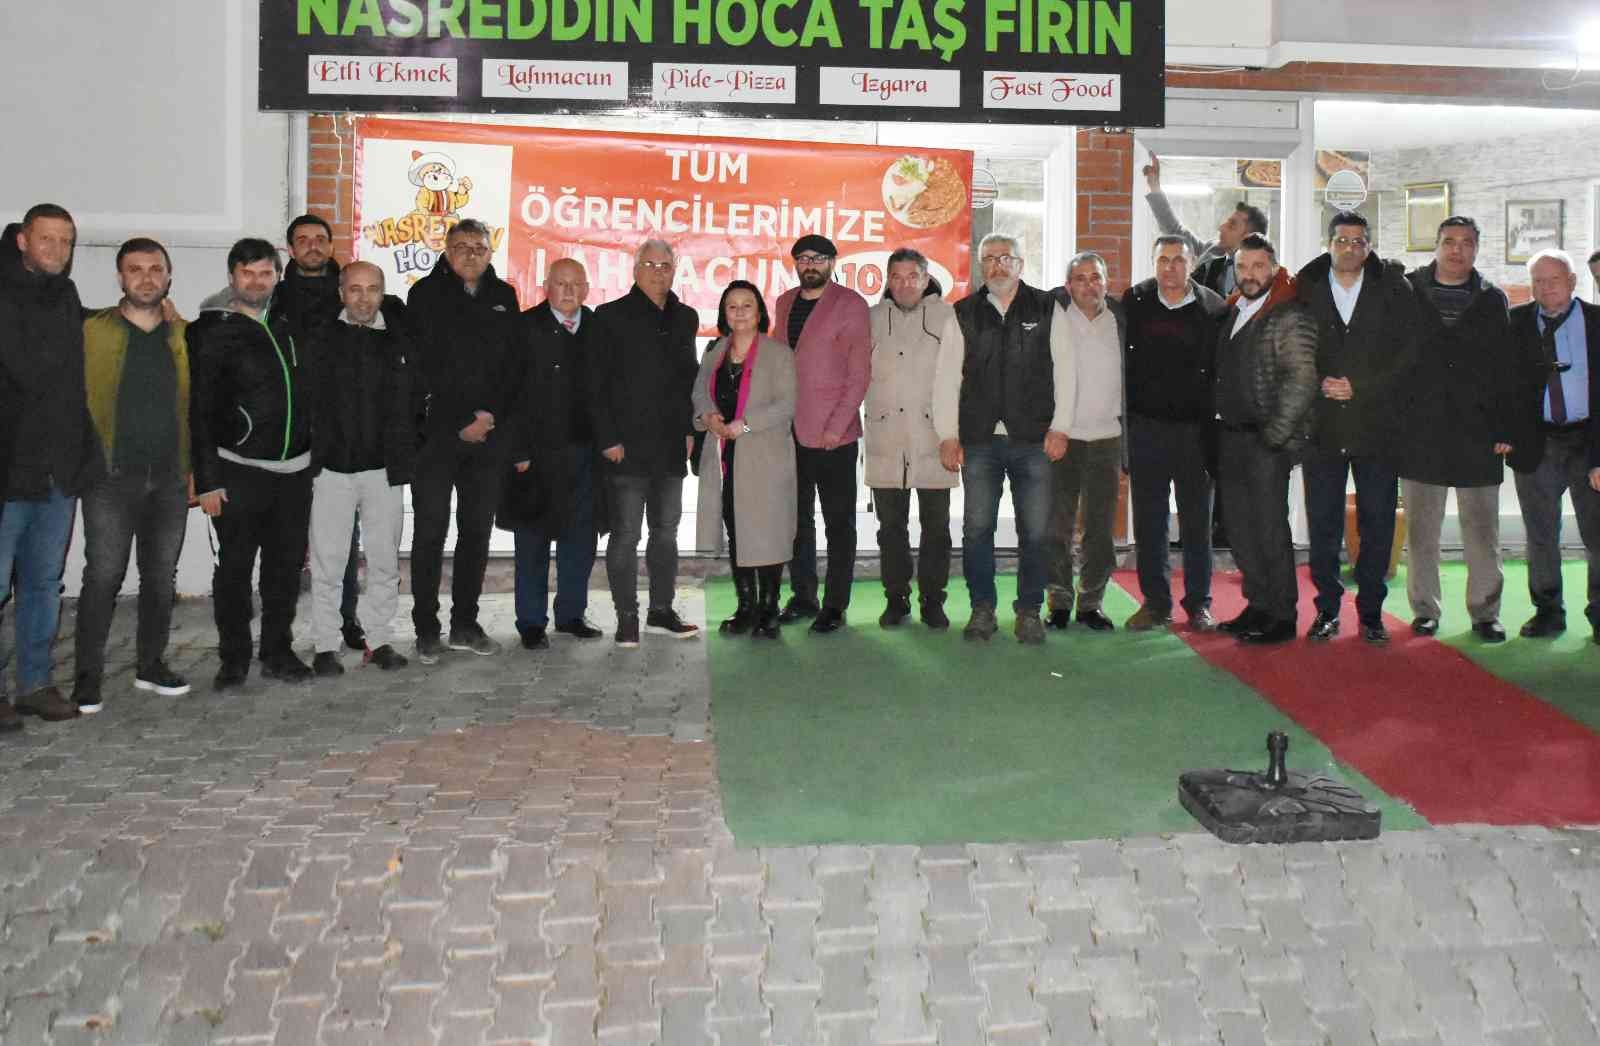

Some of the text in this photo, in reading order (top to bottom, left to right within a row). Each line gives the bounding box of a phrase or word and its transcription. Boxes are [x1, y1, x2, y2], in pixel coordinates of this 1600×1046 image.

[673, 0, 843, 48] HOCA
[859, 0, 968, 62] TAŞ
[985, 0, 1132, 55] FIRIN
[314, 60, 452, 82] Etli Ekmek
[498, 64, 612, 92] Lahmacun
[661, 68, 786, 97] Pide-Pizza
[852, 73, 928, 100] Izgara
[990, 75, 1114, 102] Fast Food
[665, 144, 748, 184] TÜM
[521, 186, 885, 242] ÖĞRENCİLERİMİZE
[841, 262, 883, 295] 10
